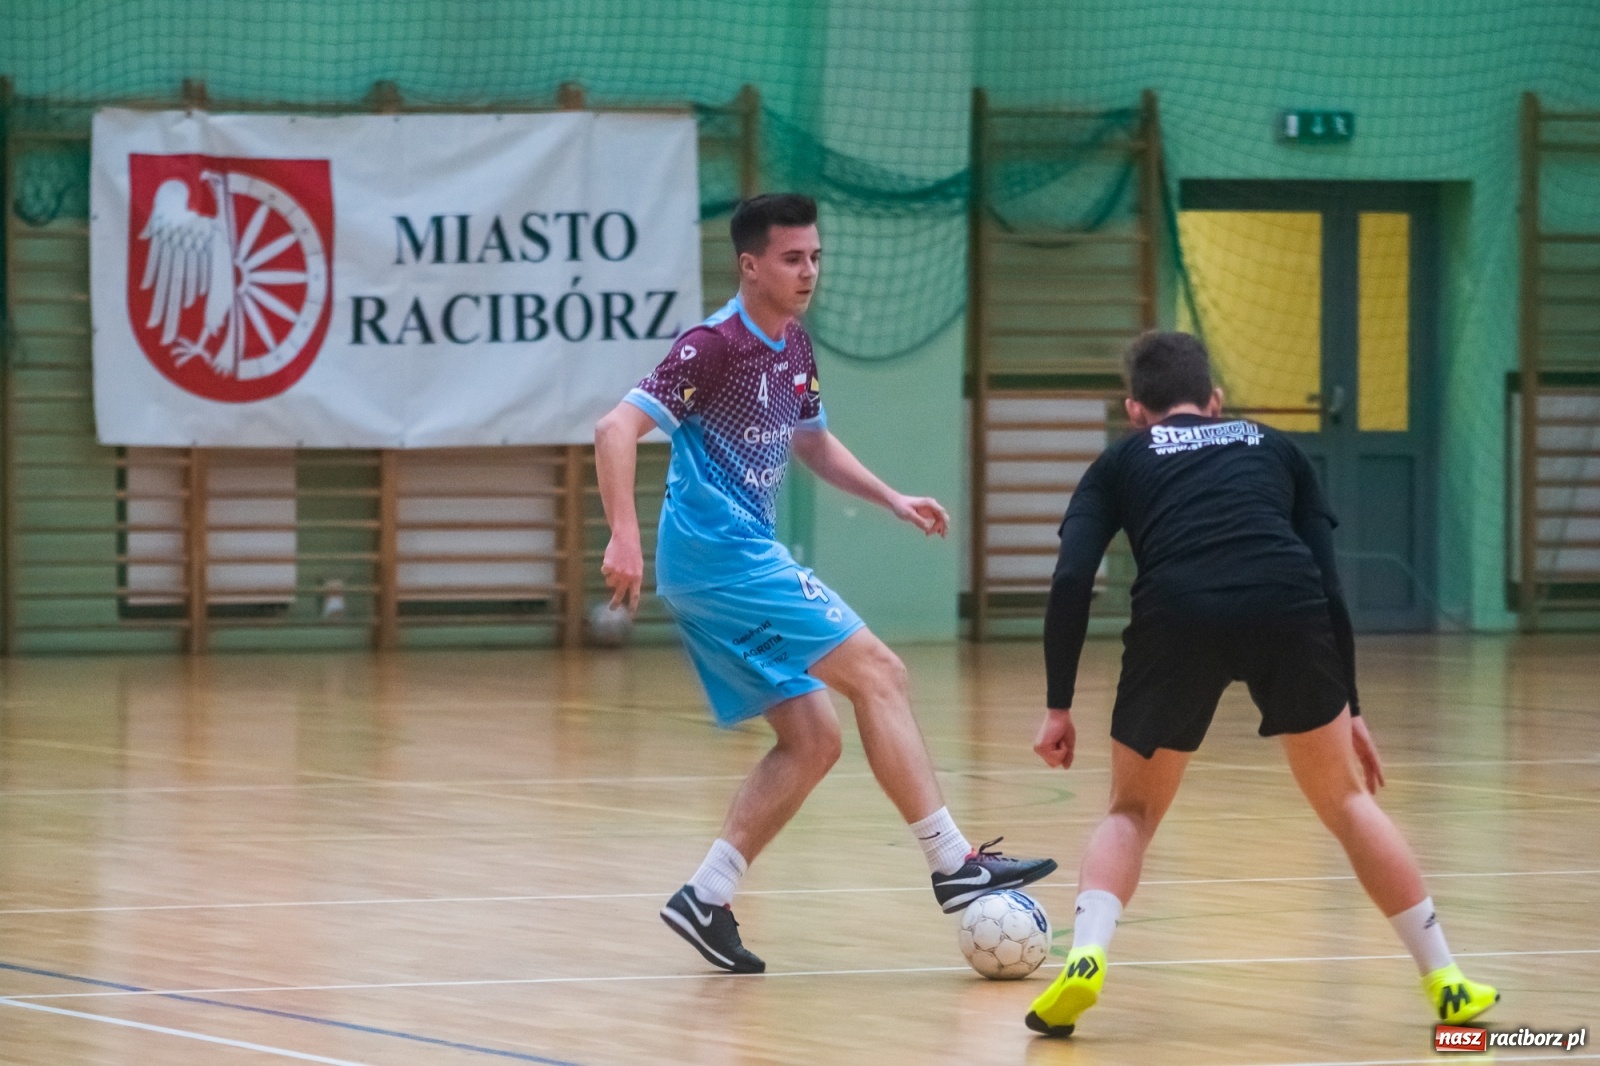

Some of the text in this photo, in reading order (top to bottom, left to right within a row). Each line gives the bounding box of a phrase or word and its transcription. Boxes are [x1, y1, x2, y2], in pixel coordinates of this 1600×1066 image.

[392, 211, 638, 265] MIASTO
[349, 276, 681, 344] RACIBÓRZ
[758, 372, 769, 408] 4
[796, 571, 830, 604] 4
